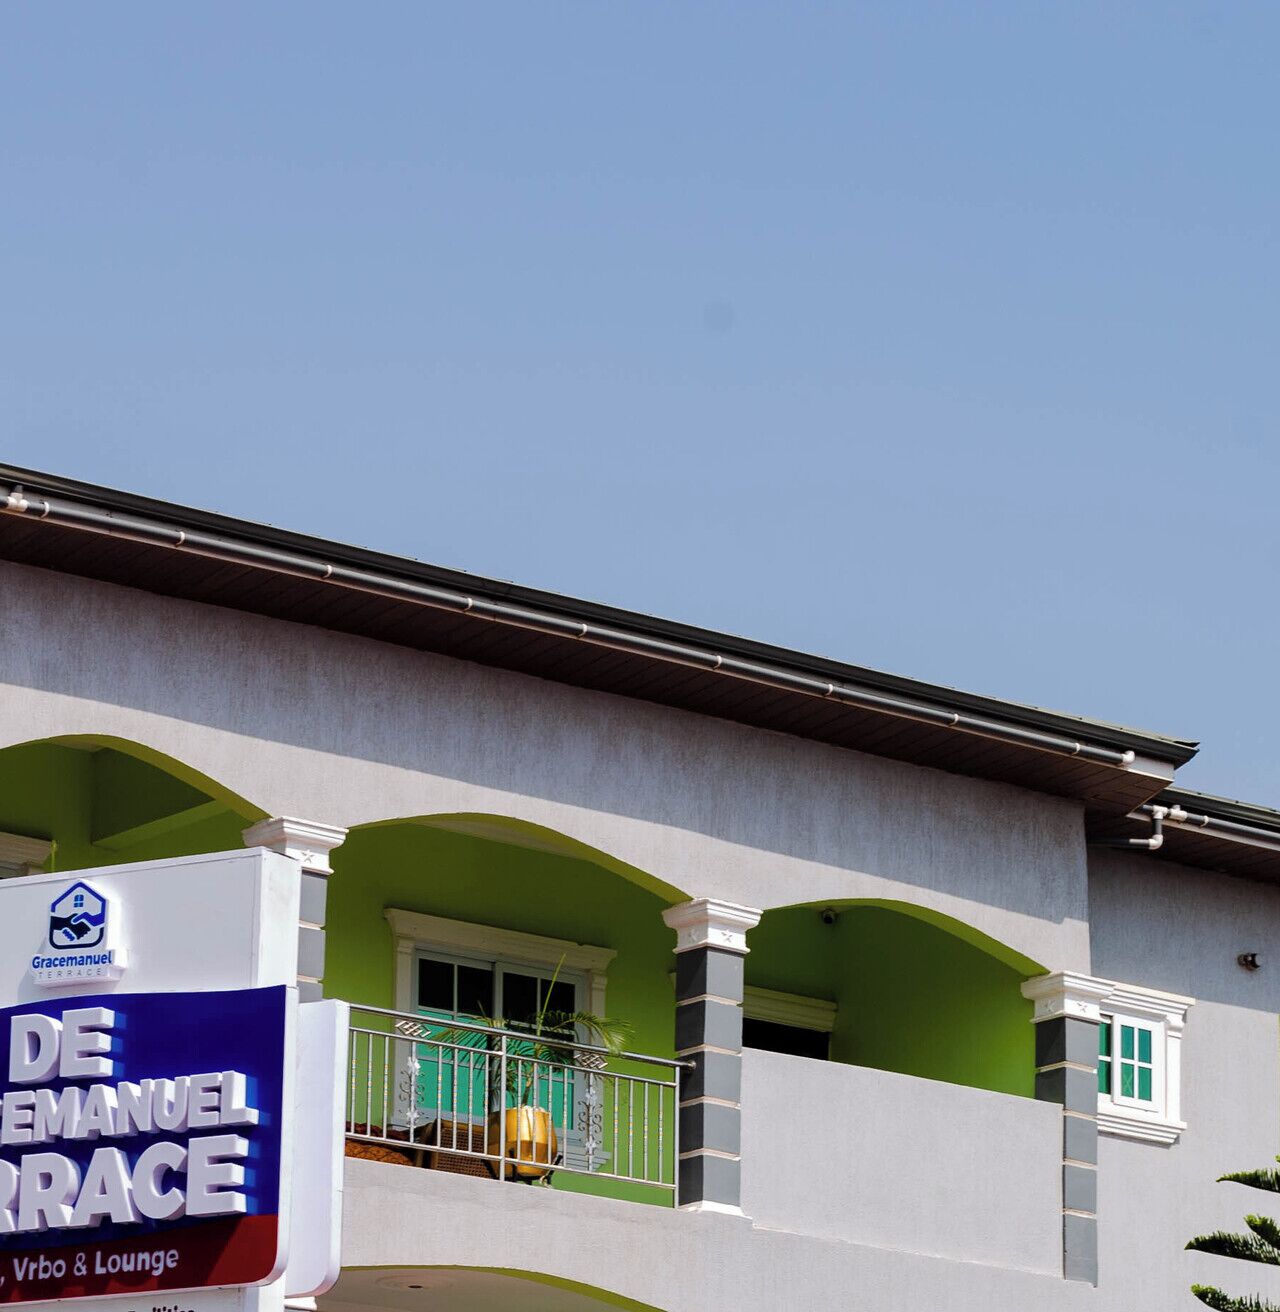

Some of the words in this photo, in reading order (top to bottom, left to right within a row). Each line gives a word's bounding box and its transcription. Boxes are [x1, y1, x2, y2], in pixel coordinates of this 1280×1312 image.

[32, 950, 112, 969] Gracemanuel
[38, 967, 101, 979] TERRACE
[9, 1007, 115, 1085] DE
[13, 1254, 67, 1281] Vrbo
[73, 1252, 87, 1276] &
[95, 1249, 179, 1276] Lounge
